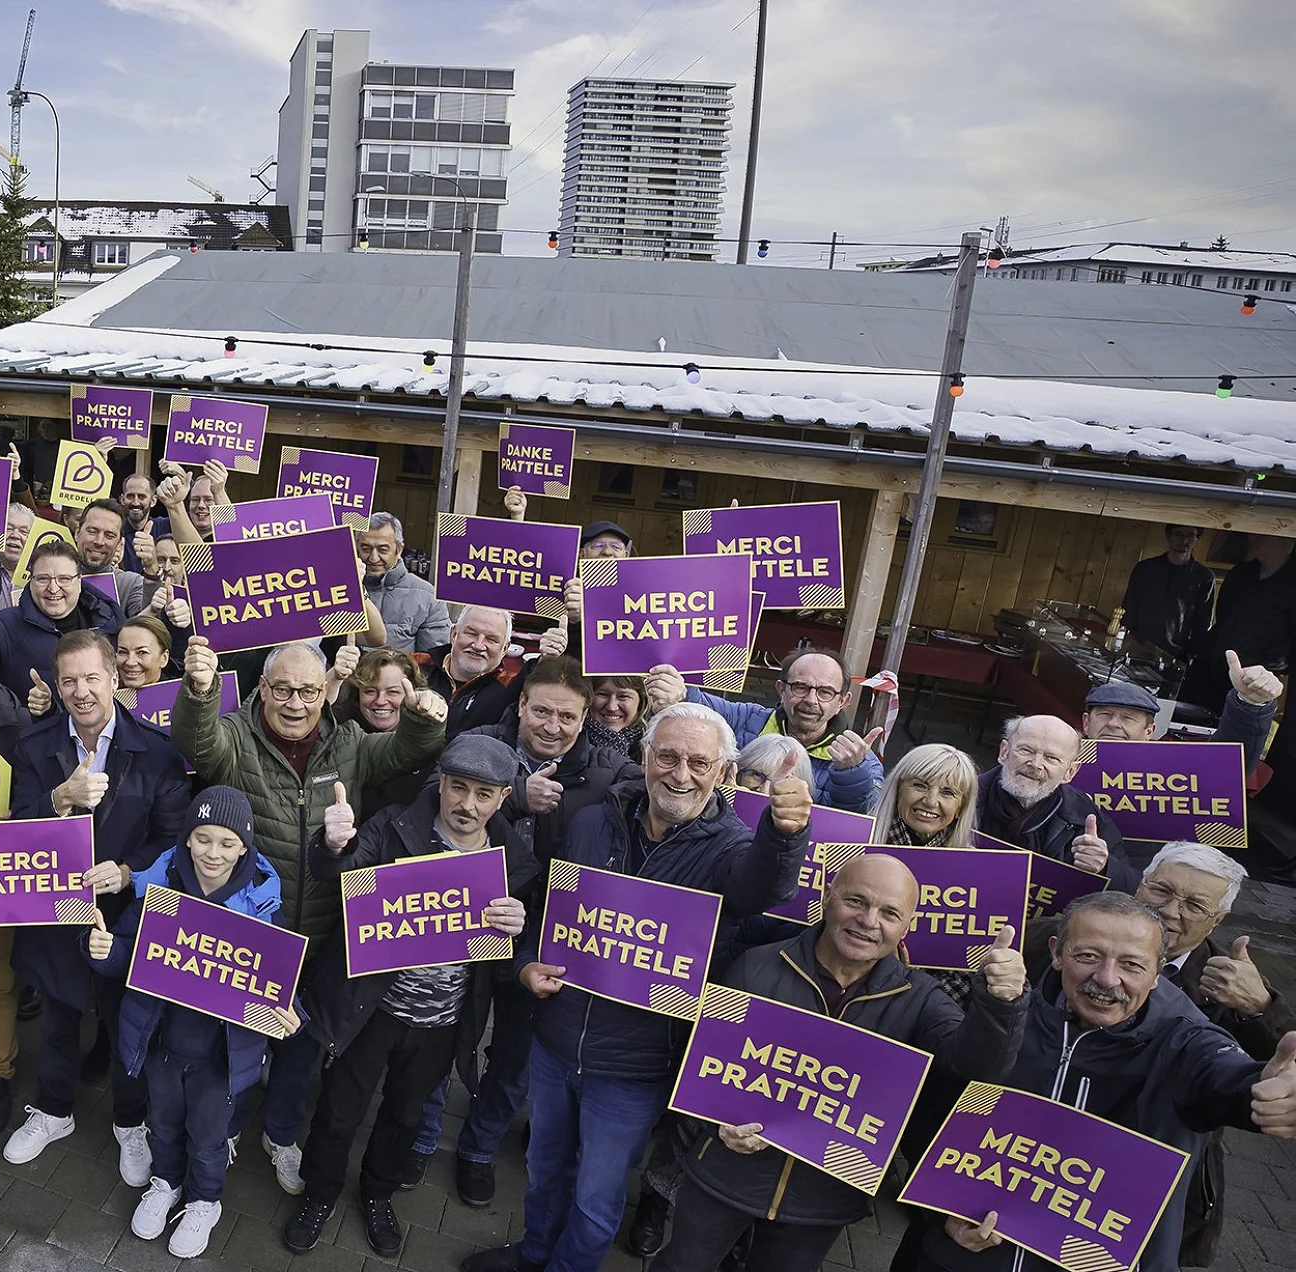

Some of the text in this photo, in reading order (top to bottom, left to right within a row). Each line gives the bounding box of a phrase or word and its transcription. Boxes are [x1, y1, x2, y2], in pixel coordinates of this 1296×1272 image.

[88, 403, 131, 417] MERCI
[76, 416, 144, 431] PRATTELE
[191, 417, 243, 434] MERCI
[174, 431, 255, 452] PRATTELE
[507, 443, 553, 461] DANKE
[299, 470, 351, 489] MERCI
[501, 458, 564, 478] PRATTELE
[241, 519, 307, 540] MERCI
[468, 543, 543, 569] MERCI
[717, 535, 801, 555] MERCI
[446, 561, 564, 592] PRATTELE
[751, 558, 829, 578] TTELE
[221, 566, 317, 599] MERCI
[202, 584, 350, 627] PRATTELE
[624, 590, 714, 615] MERCI
[597, 615, 738, 641] PRATTELE
[1102, 771, 1198, 792] MERCI
[1086, 793, 1230, 816] RATTELE
[382, 887, 470, 917] MERCI
[920, 884, 978, 909] RCI
[577, 903, 668, 946] MERCI
[910, 911, 1009, 937] TTELE
[176, 927, 261, 972] MERCI
[552, 923, 694, 980] PRATTELE
[147, 942, 283, 1002] PRATTELE
[740, 1036, 862, 1100] MERCI
[698, 1055, 885, 1146] PRATTELE
[979, 1127, 1105, 1193] MERCI
[934, 1147, 1132, 1243] PRATTELE
